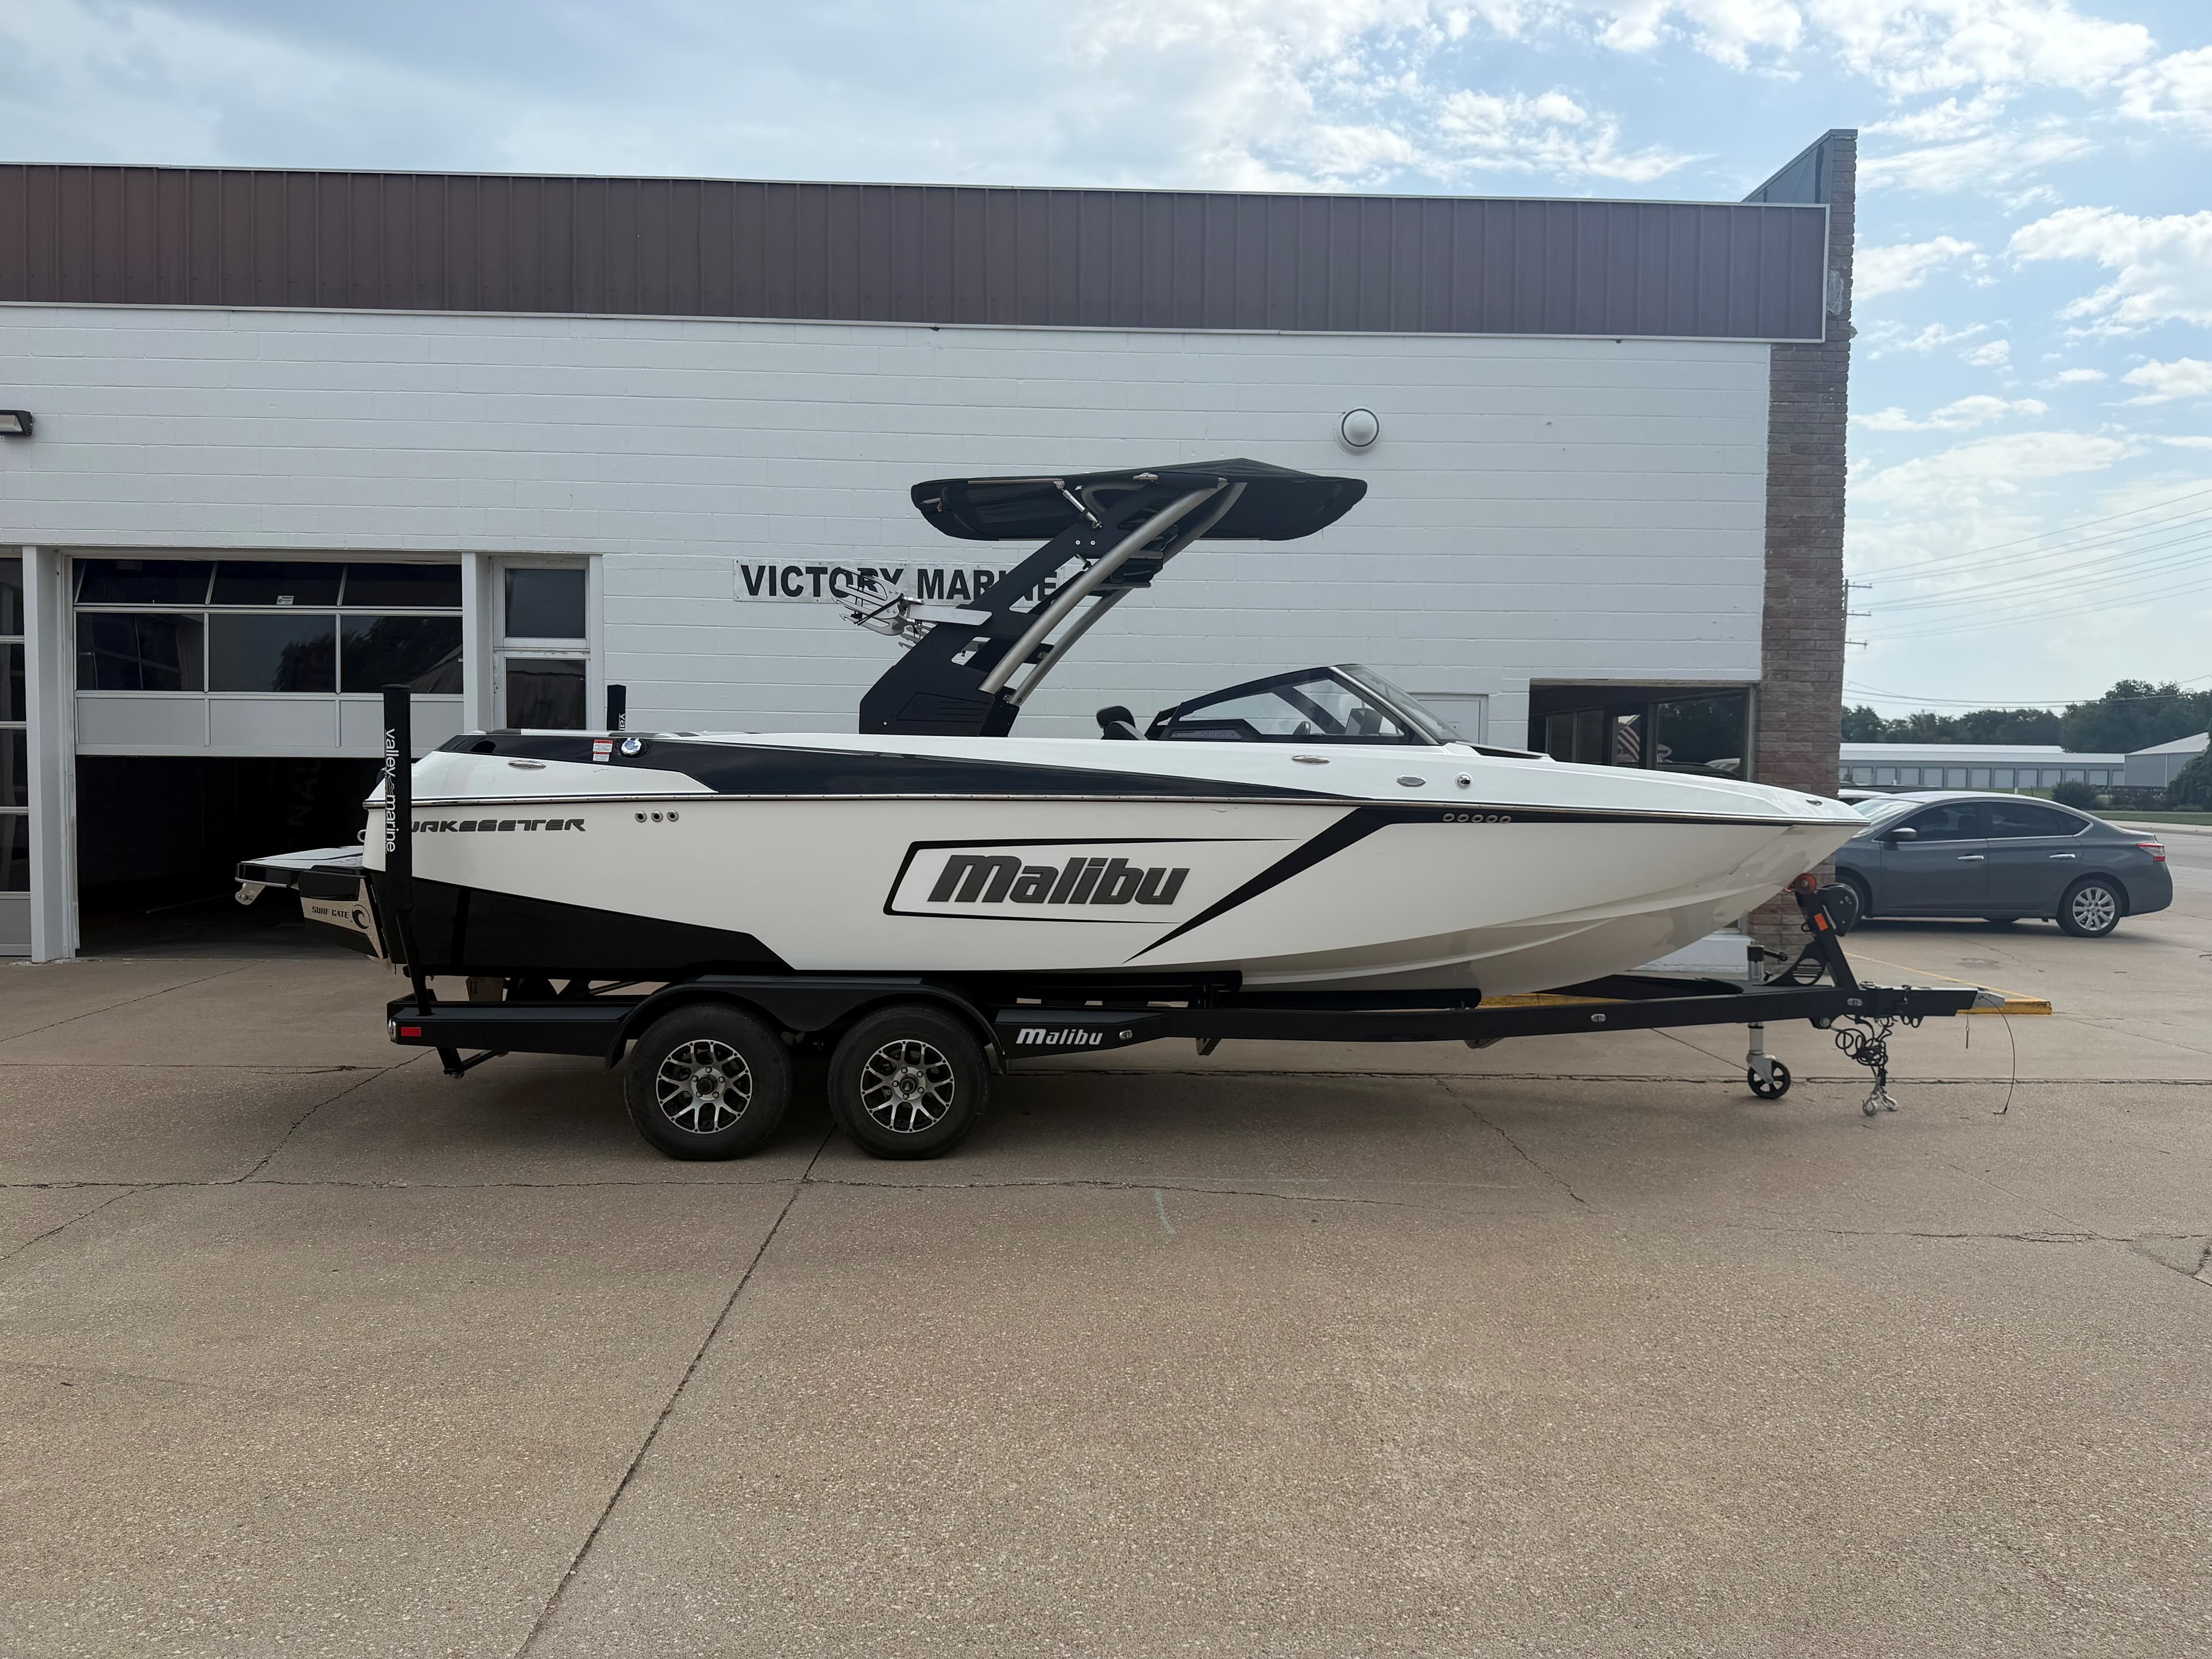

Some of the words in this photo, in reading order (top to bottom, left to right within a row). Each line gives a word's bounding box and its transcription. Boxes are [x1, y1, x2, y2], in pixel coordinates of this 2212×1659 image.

[918, 569, 1057, 600] MARE
[385, 728, 399, 777] valley
[387, 794, 399, 853] marine
[927, 854, 1191, 905] Malibu
[312, 906, 329, 915] SURF
[332, 910, 350, 918] GATE
[1016, 1028, 1103, 1045] Malibu
